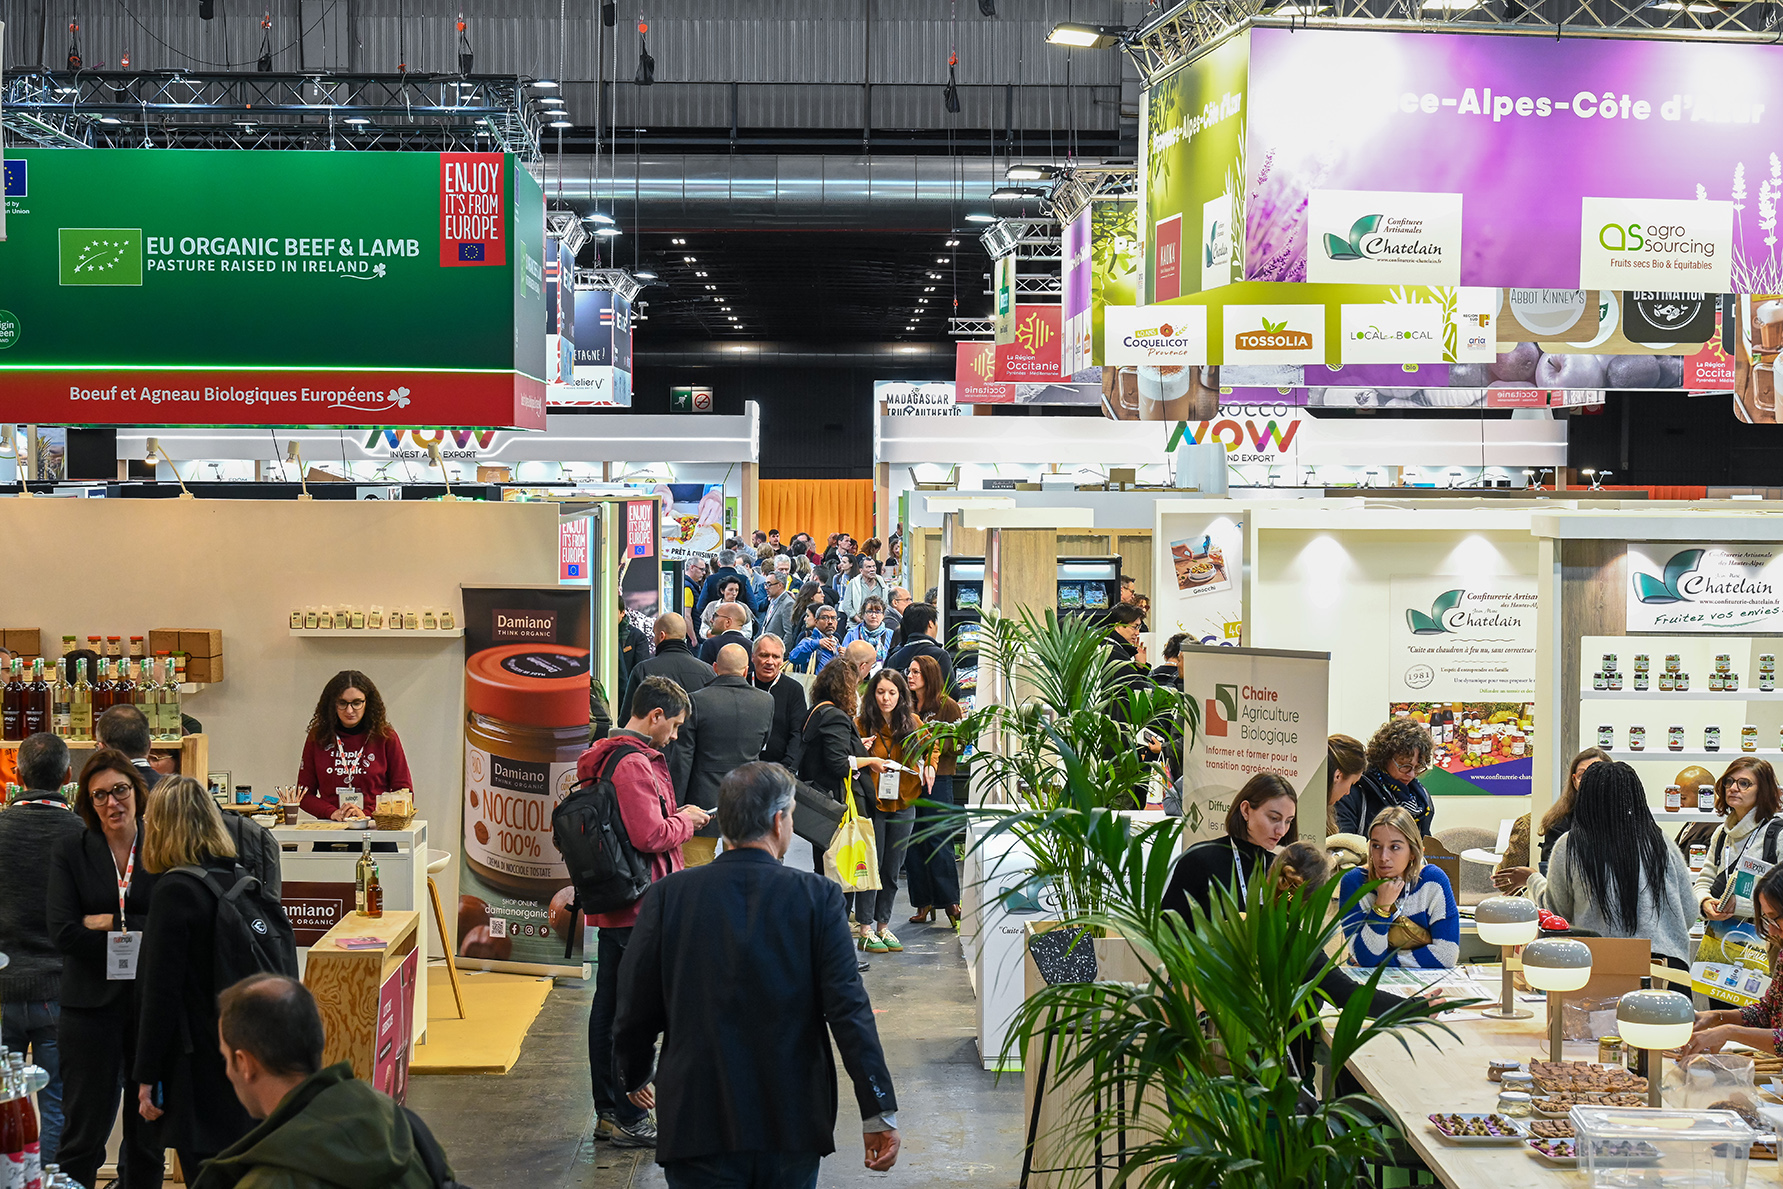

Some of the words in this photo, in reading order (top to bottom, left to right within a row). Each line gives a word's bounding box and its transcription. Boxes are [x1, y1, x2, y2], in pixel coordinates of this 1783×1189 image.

[1399, 87, 1651, 122] ce-Alpes-Côte
[445, 162, 499, 193] ENJOY
[445, 194, 466, 214] IT'S
[469, 194, 498, 214] FROM
[445, 215, 498, 240] EUROPE
[1387, 218, 1423, 226] Confitures
[1383, 226, 1422, 234] Artisanales
[1647, 225, 1686, 240] agro
[147, 237, 174, 255] EU
[179, 238, 279, 256] ORGANIC
[284, 238, 335, 256] BEEF
[339, 239, 353, 256] &
[358, 239, 420, 257] LAMB
[1366, 238, 1442, 255] Chatelain
[1645, 239, 1715, 257] Sourcing
[147, 259, 215, 272] PASTURE
[221, 260, 277, 272] RAISED
[282, 260, 297, 272] IN
[303, 260, 369, 273] IRELAND
[1610, 258, 1632, 268] Fruits
[1633, 259, 1651, 268] secs
[1652, 259, 1665, 268] Bio
[1666, 260, 1673, 268] &
[1673, 258, 1713, 271] Équitables
[1633, 290, 1705, 301] DESTINATION
[1240, 336, 1308, 347] TOSSOLIA
[1147, 348, 1188, 357] Provence
[1007, 361, 1059, 370] Occitanie
[69, 386, 118, 401] Boeuf
[120, 388, 136, 401] et
[140, 387, 200, 405] Agneau
[204, 387, 297, 405] Biologiques
[301, 386, 384, 405] Européens
[887, 393, 949, 404] MADAGASCAR
[1165, 420, 1302, 453] NOW
[390, 451, 419, 459] INVEST
[443, 451, 476, 459] EXPORT
[1242, 454, 1275, 462] EXPORT
[629, 505, 651, 520] ENJOY
[638, 520, 651, 532] FROM
[572, 534, 585, 546] FROM
[629, 531, 651, 544] EUROPE
[562, 548, 585, 563] EUROPE
[1684, 576, 1773, 594] Chatelain
[1467, 592, 1512, 602] Confiturerie
[497, 615, 552, 629] Damiano
[1449, 611, 1521, 627] Chatelain
[1655, 614, 1705, 625] Fruitez
[1711, 610, 1734, 619] vos
[1408, 671, 1430, 681] 1981
[1241, 685, 1279, 702] Chaire
[1241, 704, 1300, 723] Agriculture
[1241, 724, 1298, 746] Biologique
[1205, 745, 1235, 757] Informer
[1236, 748, 1244, 757] et
[1246, 748, 1269, 759] former
[1271, 753, 1289, 762] pour
[1290, 752, 1298, 762] la
[1205, 760, 1239, 770] transition
[494, 763, 545, 782] Damiano
[495, 777, 512, 785] THINK
[1208, 819, 1219, 830] les
[497, 829, 541, 858] 100%
[529, 866, 551, 877] TOSTATE
[282, 903, 335, 917] amiano
[517, 899, 538, 907] ONLINE
[484, 903, 556, 919] damianorganic.it
[1709, 987, 1740, 1003] STAND
